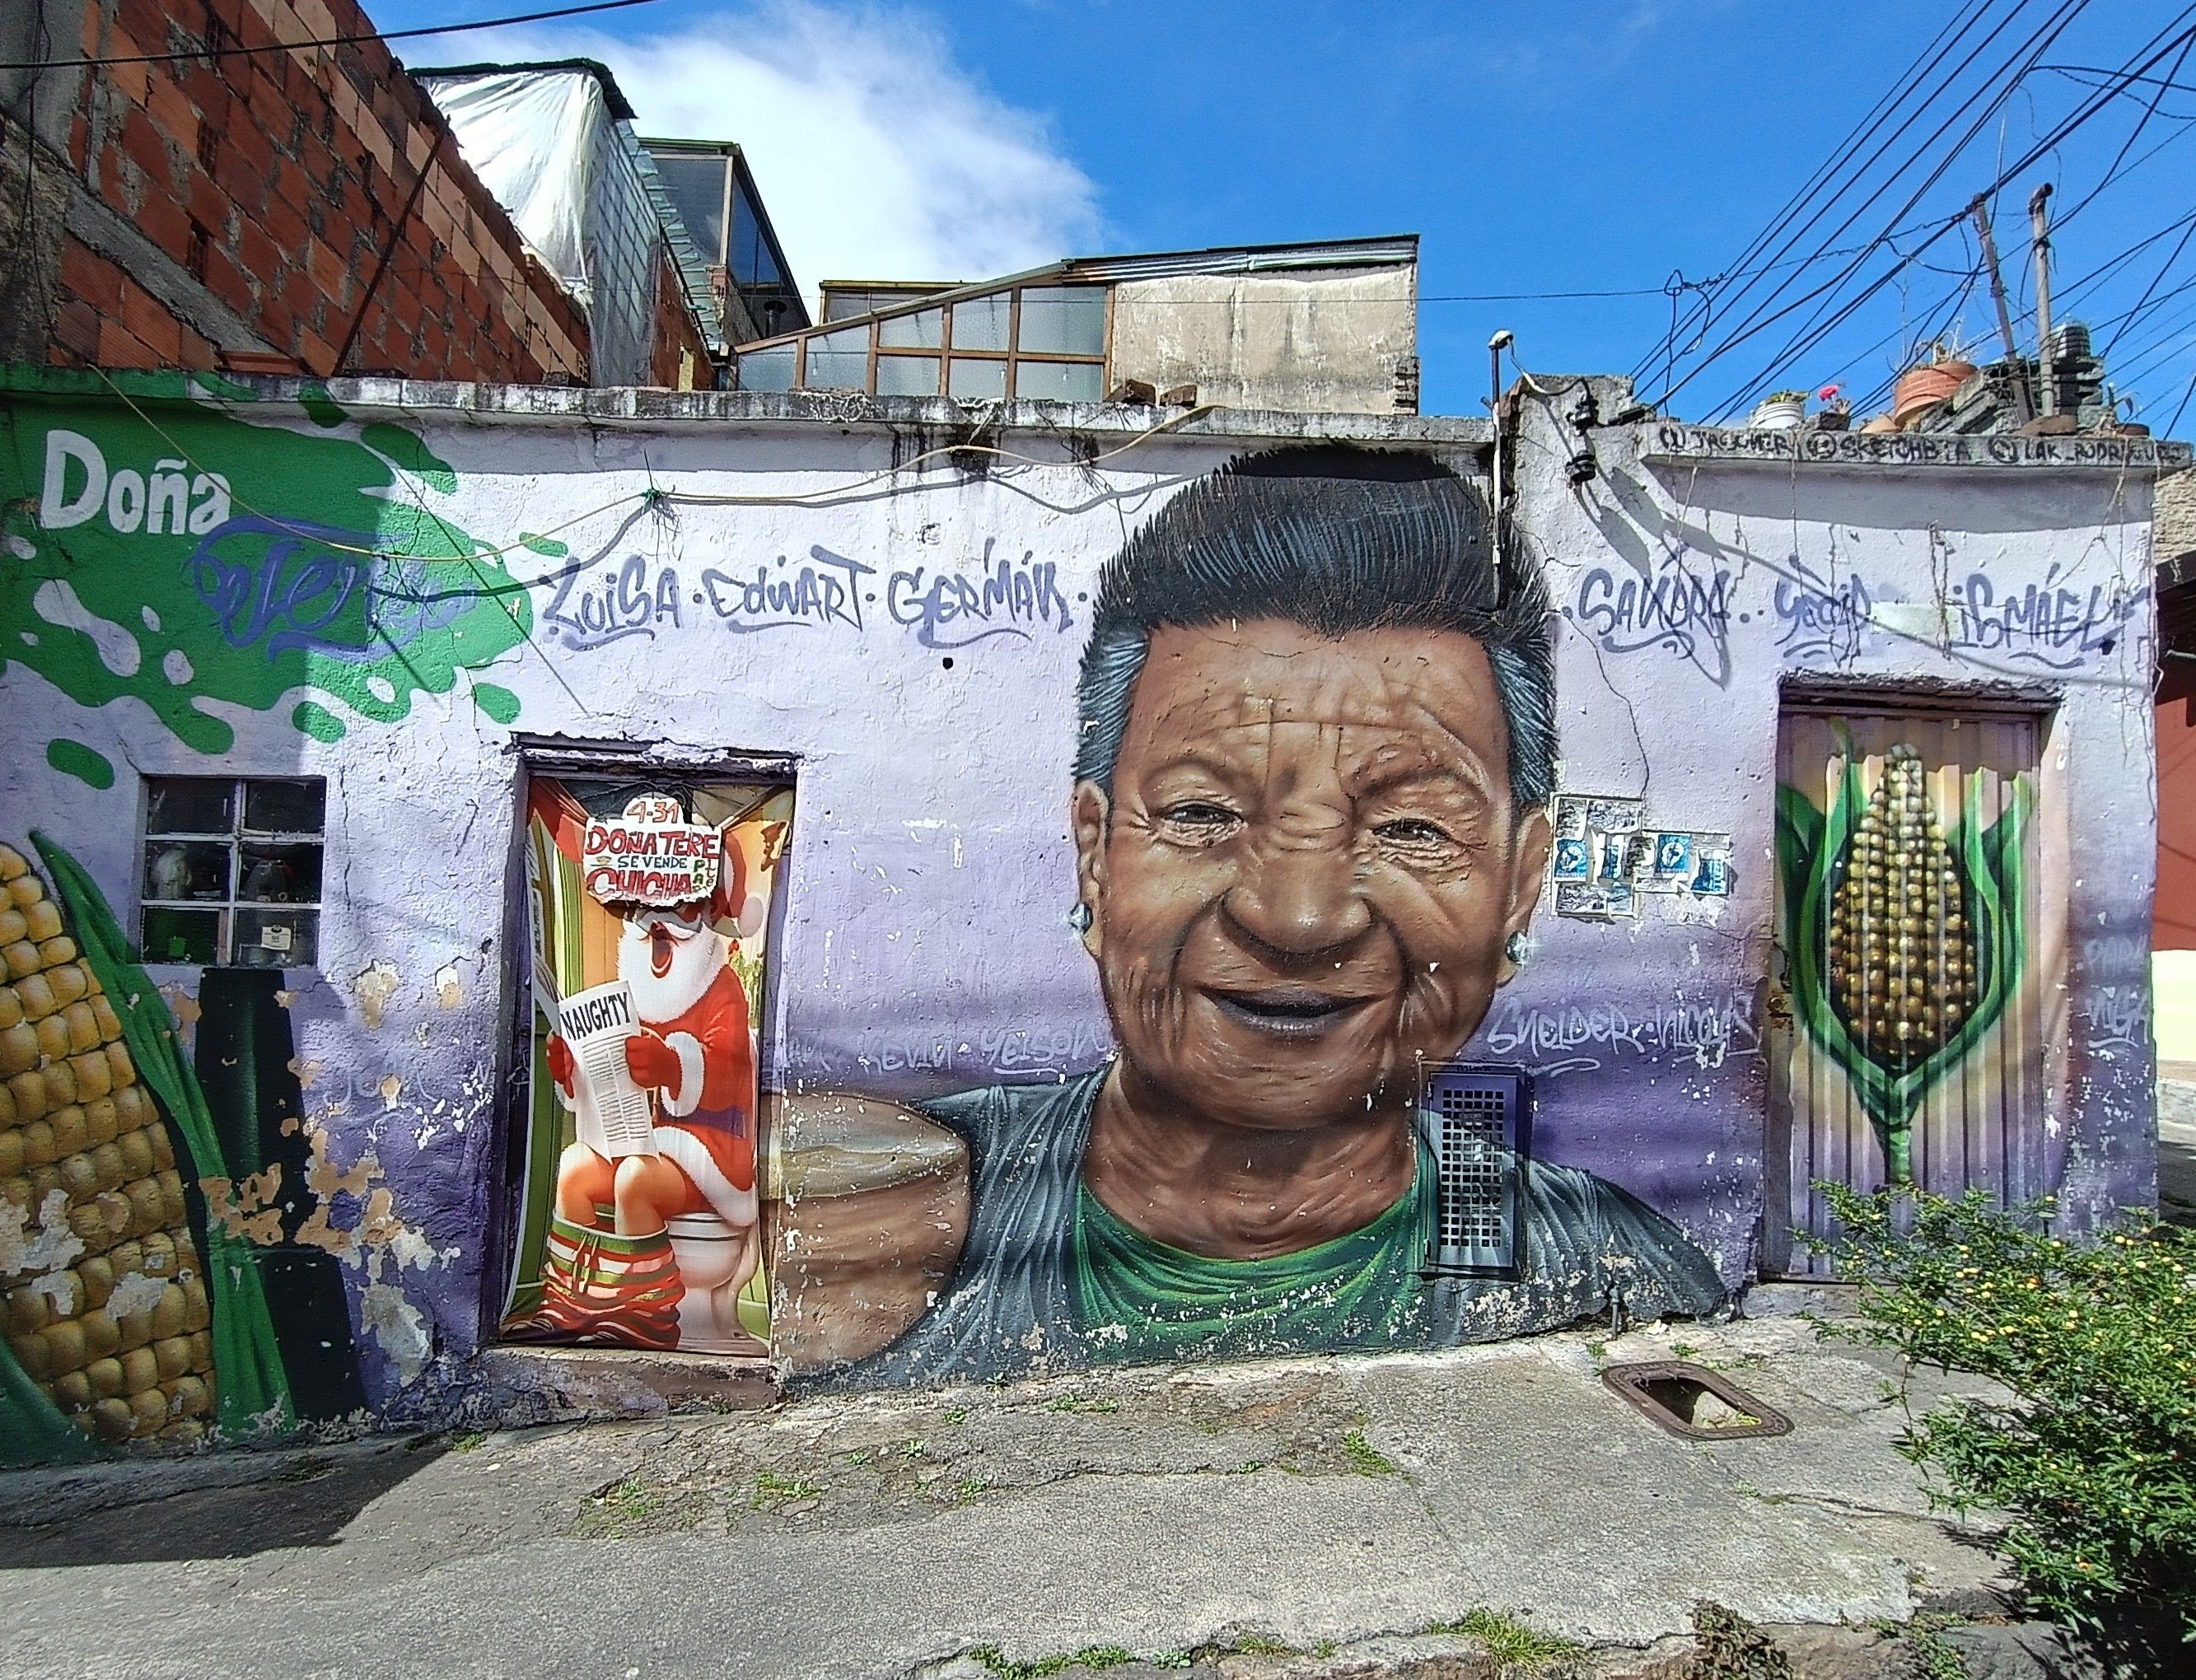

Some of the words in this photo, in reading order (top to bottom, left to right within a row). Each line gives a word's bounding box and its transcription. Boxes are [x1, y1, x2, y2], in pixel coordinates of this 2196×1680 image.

[42, 430, 231, 534] Doña
[627, 801, 680, 824] 4-31
[586, 825, 657, 855] DOÑA
[659, 830, 721, 858] TERE
[618, 856, 639, 869] SE
[642, 855, 687, 869] VENDE
[560, 992, 630, 1041] NAUGHTY
